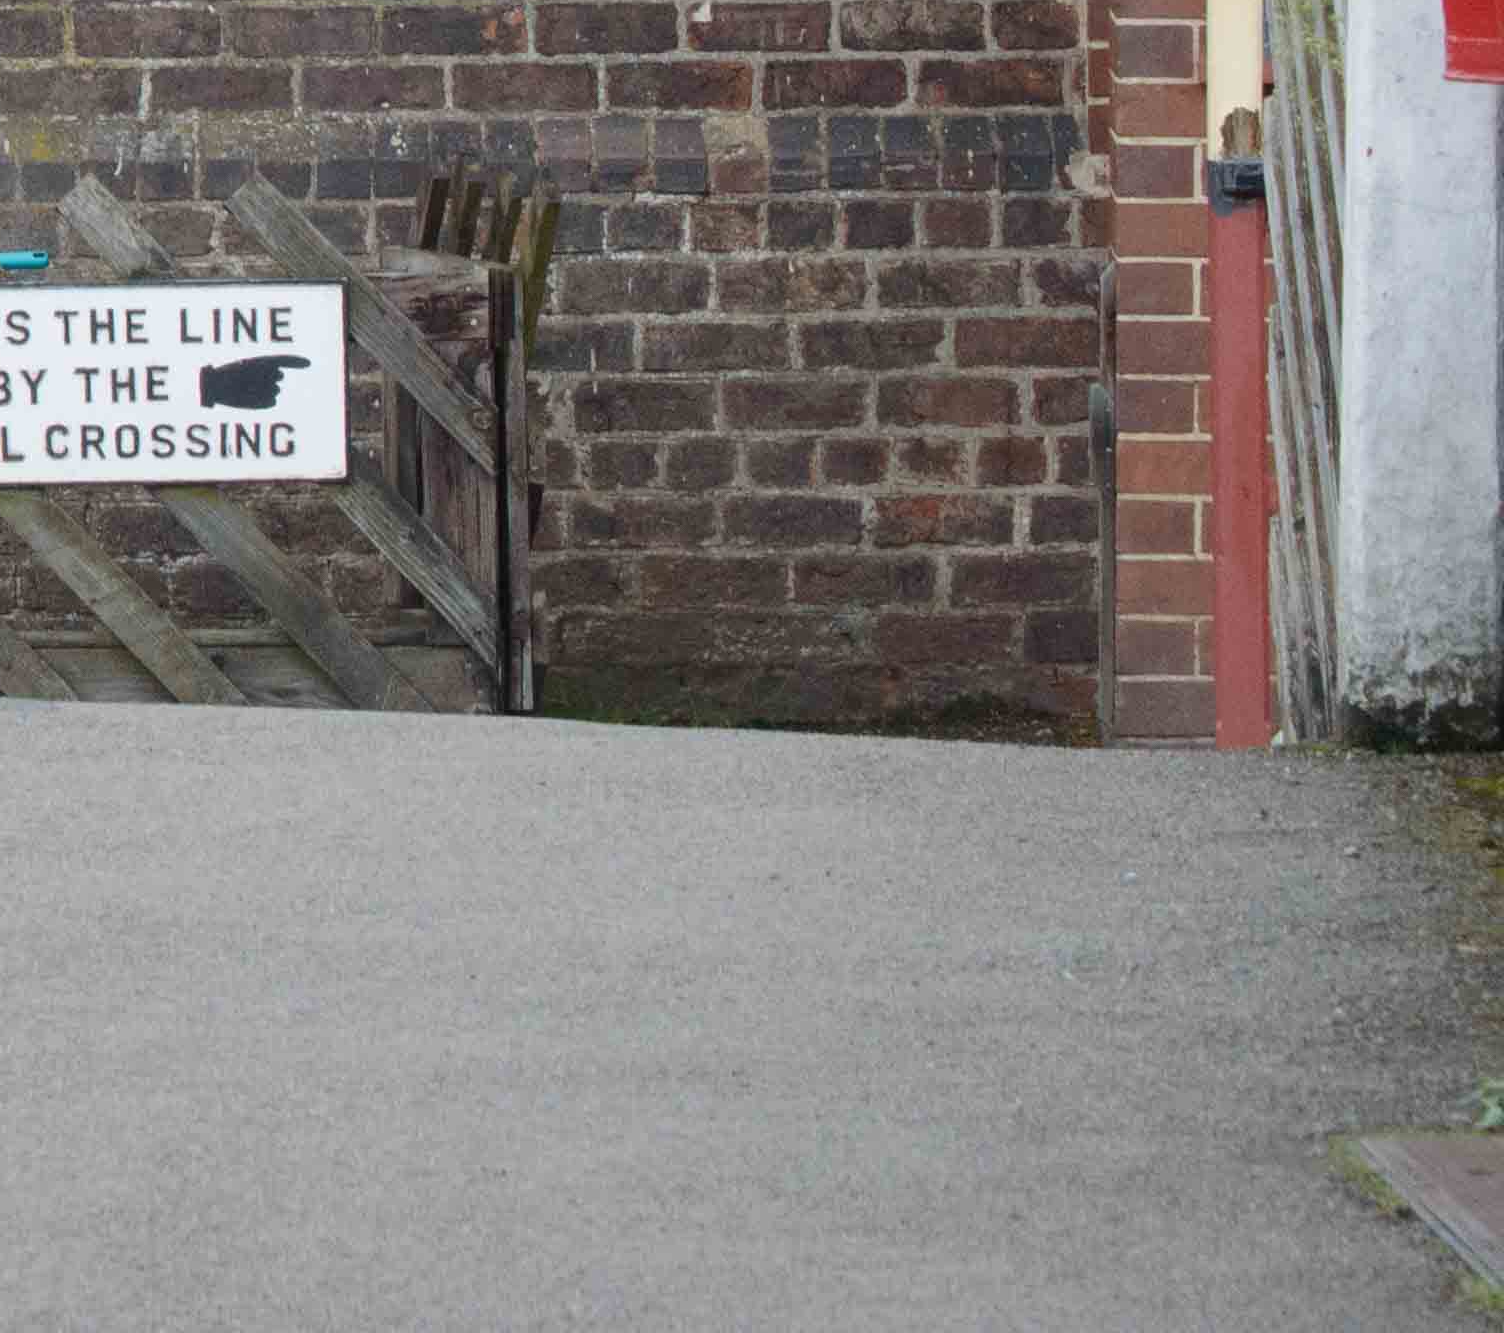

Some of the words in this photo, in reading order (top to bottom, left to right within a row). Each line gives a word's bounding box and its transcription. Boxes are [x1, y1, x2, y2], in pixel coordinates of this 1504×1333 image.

[54, 308, 149, 345] THE
[179, 306, 294, 344] LINE
[73, 365, 170, 403] THE
[44, 423, 297, 460] CROSSING
